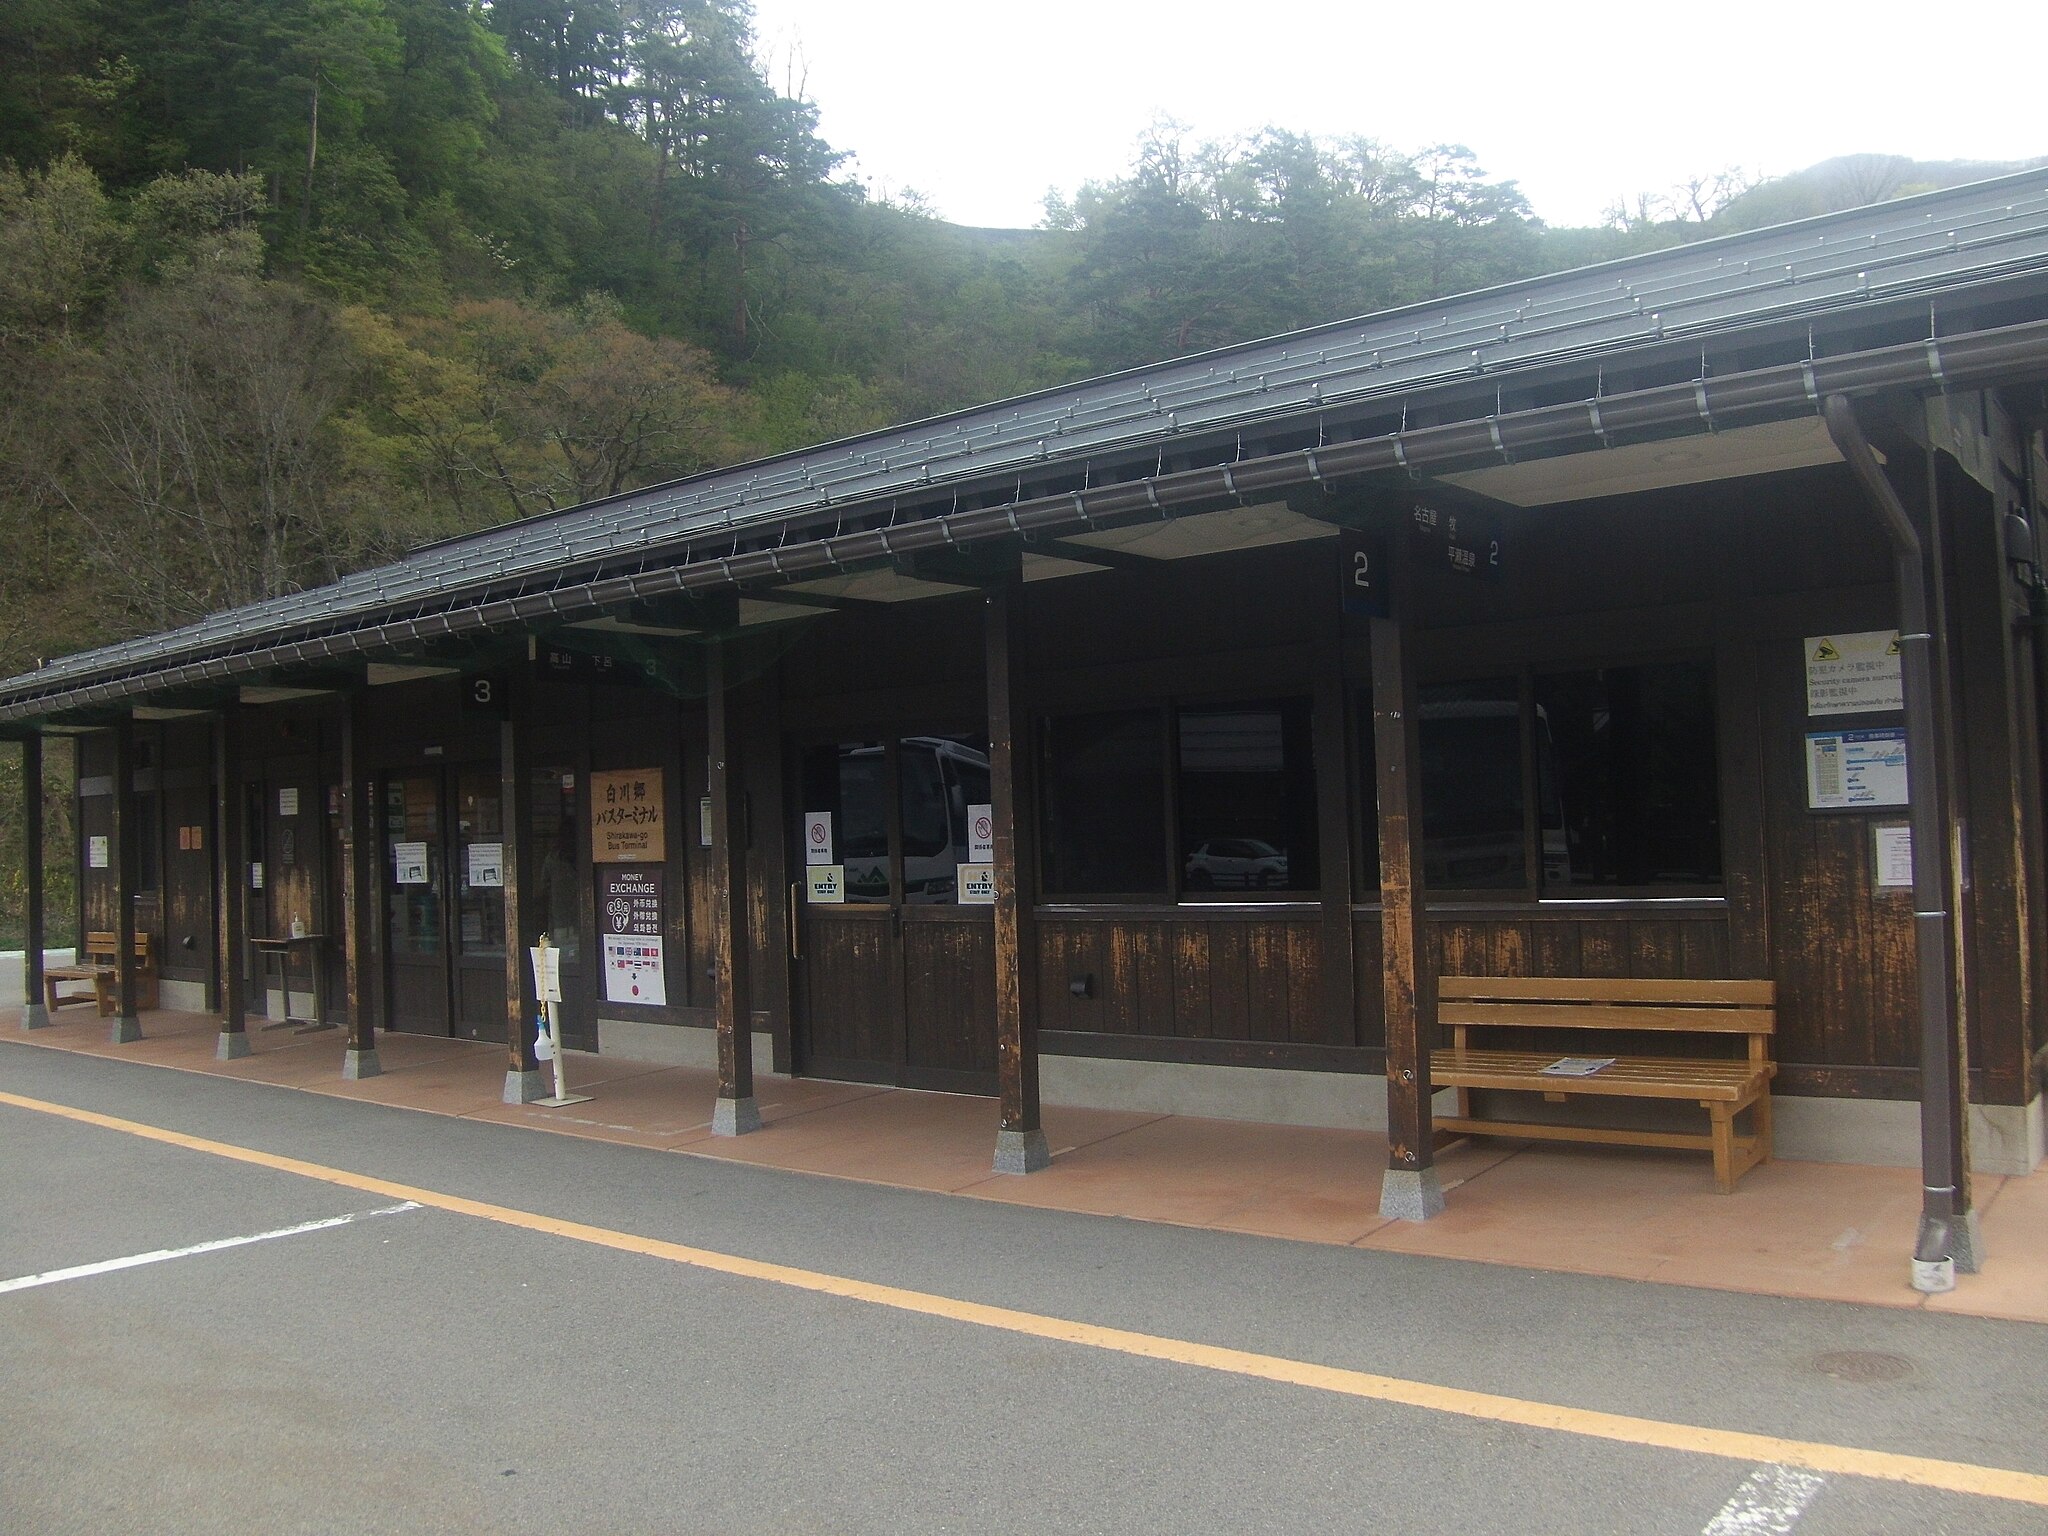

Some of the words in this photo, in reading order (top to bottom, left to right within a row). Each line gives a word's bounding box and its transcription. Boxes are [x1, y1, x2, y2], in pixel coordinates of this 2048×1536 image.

[1414, 505, 1437, 526] 名古屋
[1490, 540, 1499, 566] 2
[1354, 551, 1369, 587] 2
[550, 652, 572, 664] 高山
[592, 655, 612, 667] 下呂
[646, 659, 656, 675] 3
[1809, 678, 1841, 687] Security
[1842, 675, 1870, 684] camera
[475, 679, 491, 703] 3
[1848, 733, 1854, 741] 2
[607, 781, 646, 804] 白川郷
[596, 805, 658, 825] バスターミナル
[606, 831, 648, 841] Shirakawa-go
[608, 841, 620, 850] Bus
[621, 840, 648, 850] Terminal
[621, 873, 643, 882] MONEY
[610, 883, 655, 894] EXCHANGE
